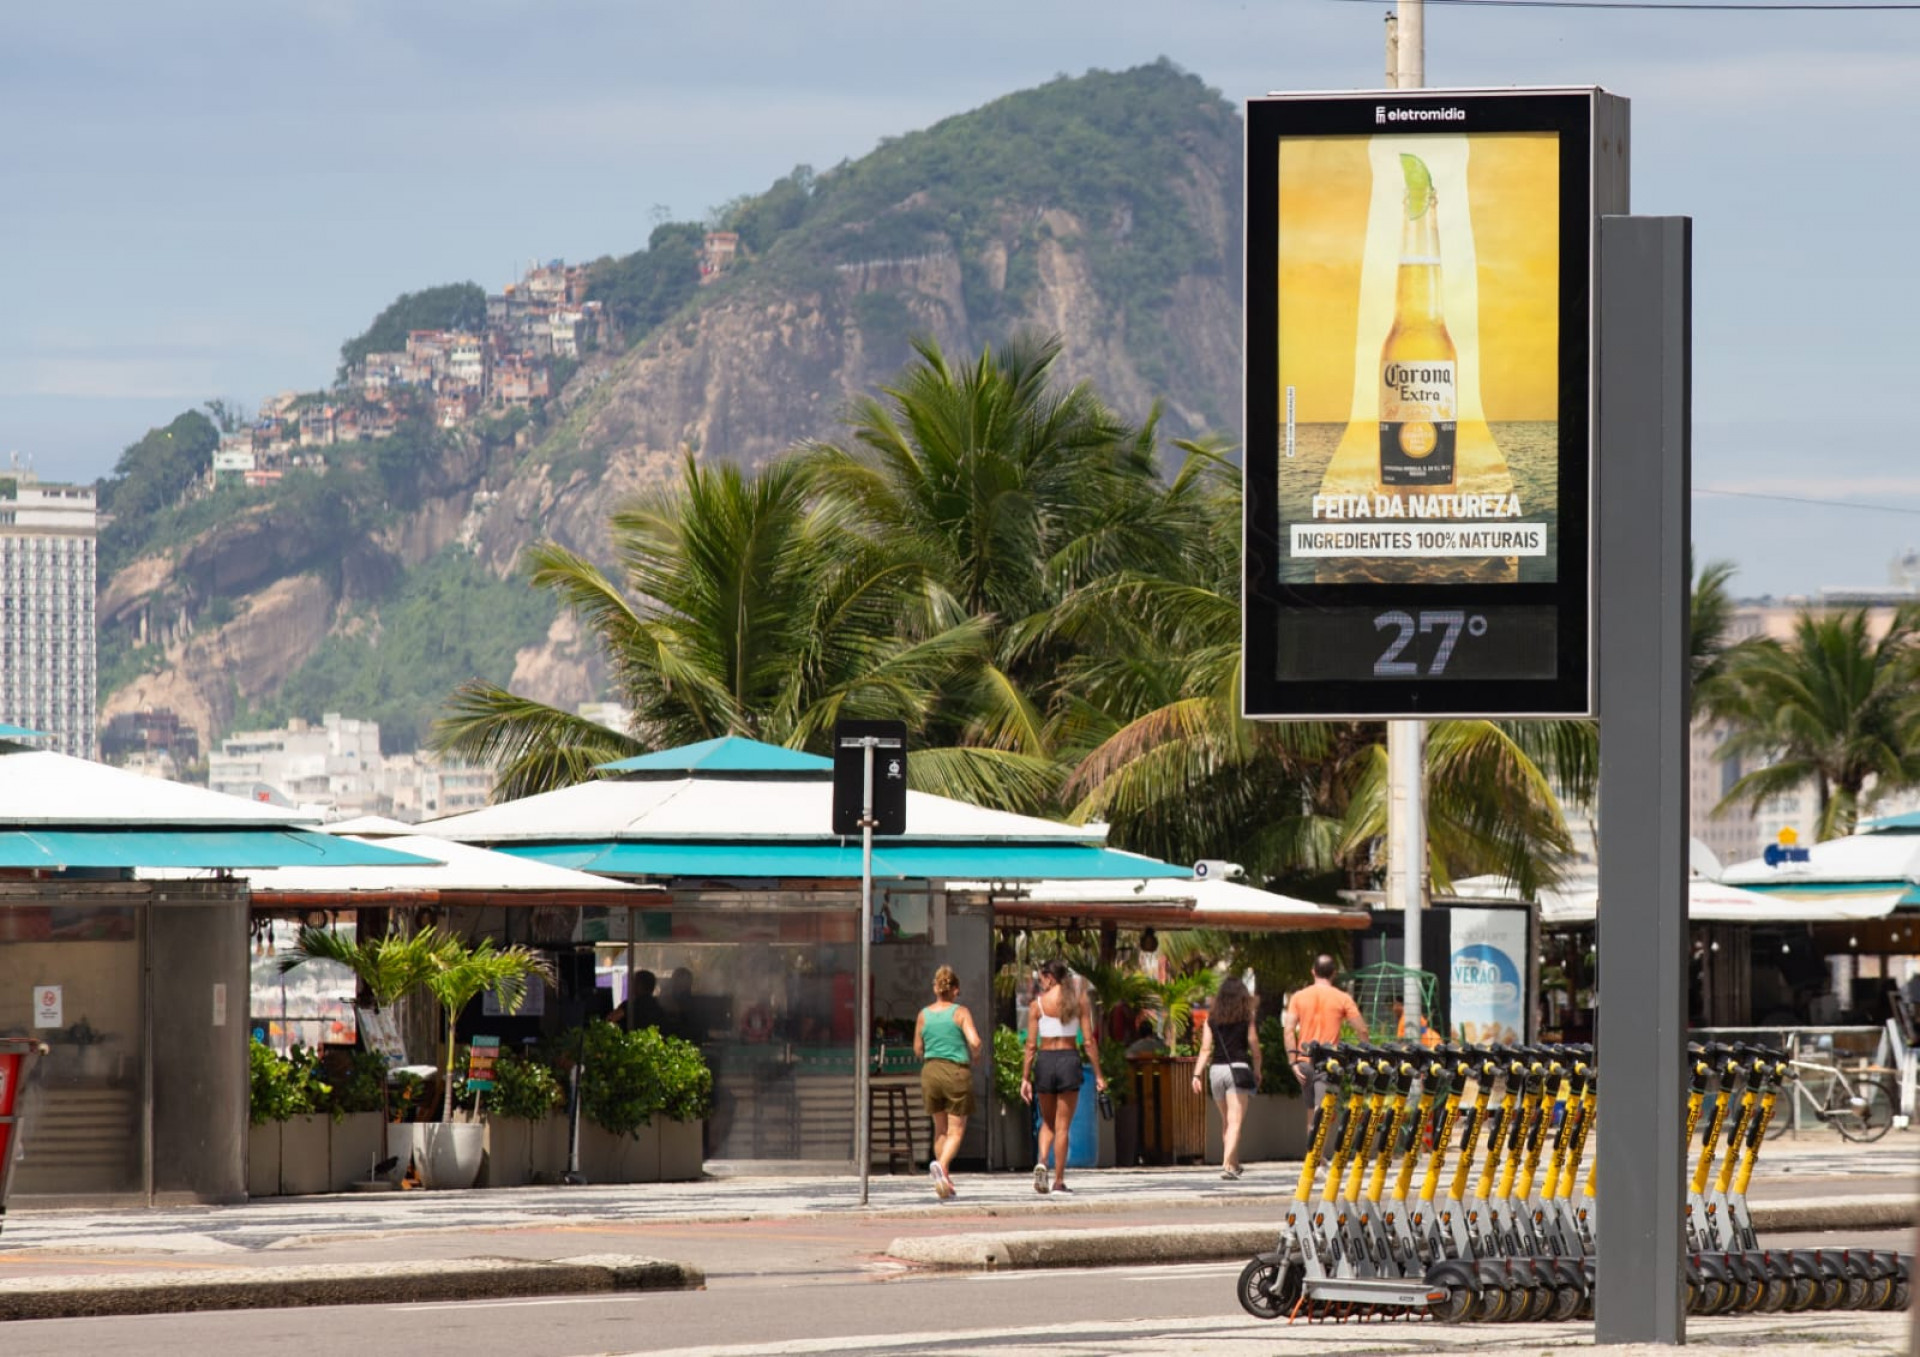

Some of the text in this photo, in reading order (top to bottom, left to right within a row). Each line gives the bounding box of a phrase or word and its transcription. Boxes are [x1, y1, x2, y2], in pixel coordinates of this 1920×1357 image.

[1387, 107, 1466, 121] eletromidia
[1384, 362, 1453, 391] Corona
[1400, 385, 1440, 402] Extra
[1312, 493, 1522, 519] FEITA DA NATUREZA
[1298, 531, 1539, 550] INGREDIENTES 100% NATURAIS
[1373, 610, 1488, 676] 27°
